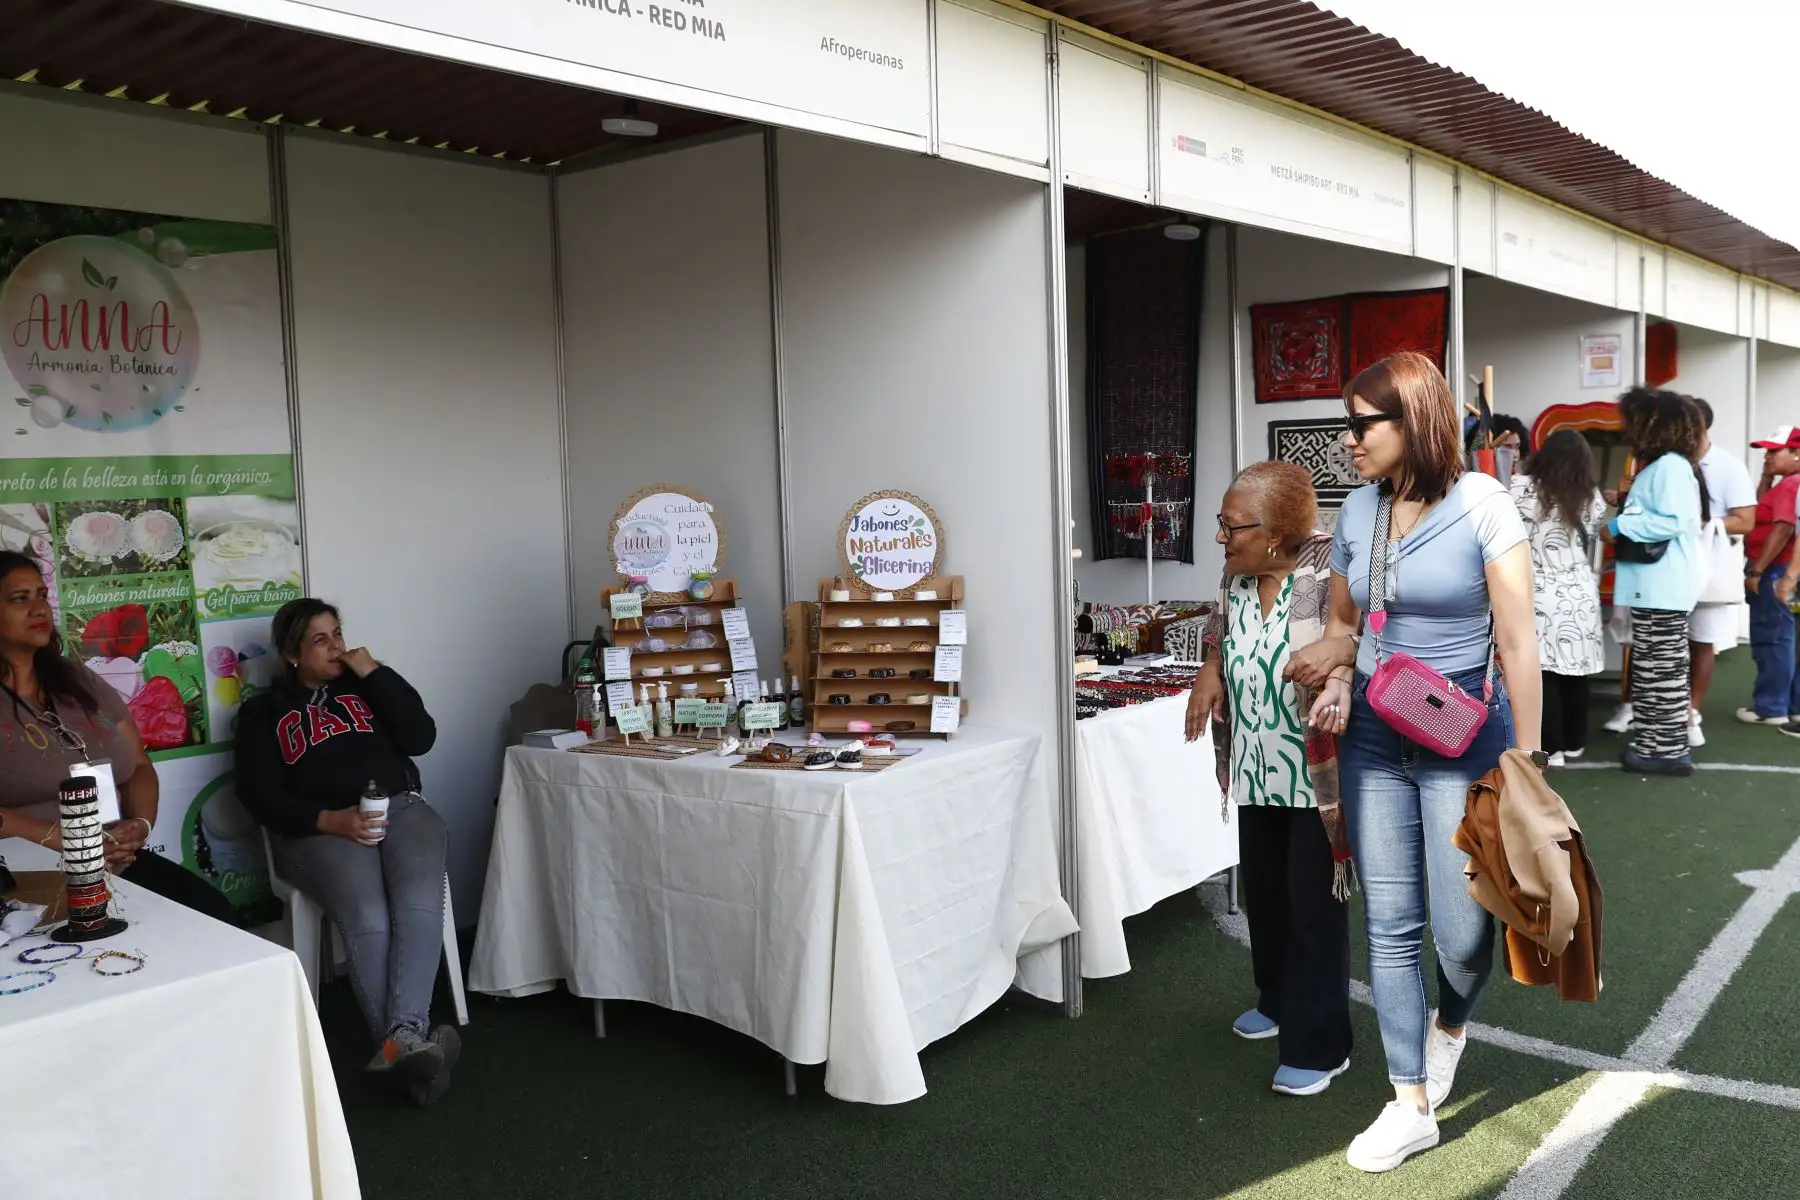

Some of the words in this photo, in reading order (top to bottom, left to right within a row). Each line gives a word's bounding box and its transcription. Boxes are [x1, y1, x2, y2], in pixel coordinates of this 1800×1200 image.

[650, 4, 687, 31] RED
[692, 15, 726, 42] MIA
[820, 36, 904, 71] Afroperuanas
[1270, 164, 1294, 182] METZÁ
[1294, 171, 1320, 188] SHIPIBO
[13, 293, 182, 355] ANNA
[110, 352, 178, 377] Botánica
[39, 467, 58, 490] de
[63, 467, 76, 489] la
[83, 466, 138, 489] belleza
[142, 469, 168, 486] está
[172, 474, 186, 486] en
[191, 464, 203, 485] lo
[207, 468, 272, 494] orgánico.
[664, 502, 711, 514] Cuidado
[678, 520, 706, 532] para
[850, 515, 909, 533] Jabones
[677, 534, 687, 545] la
[690, 533, 711, 547] piel
[850, 532, 933, 555] Naturales
[683, 552, 690, 562] y
[694, 549, 704, 559] el
[863, 556, 933, 576] Glicerina
[673, 563, 716, 576] Cabello
[68, 586, 126, 608] Jabones
[128, 578, 190, 599] naturales
[208, 587, 229, 609] Gel
[229, 592, 261, 613] para
[264, 583, 295, 603] baño
[277, 694, 374, 765] GAP
